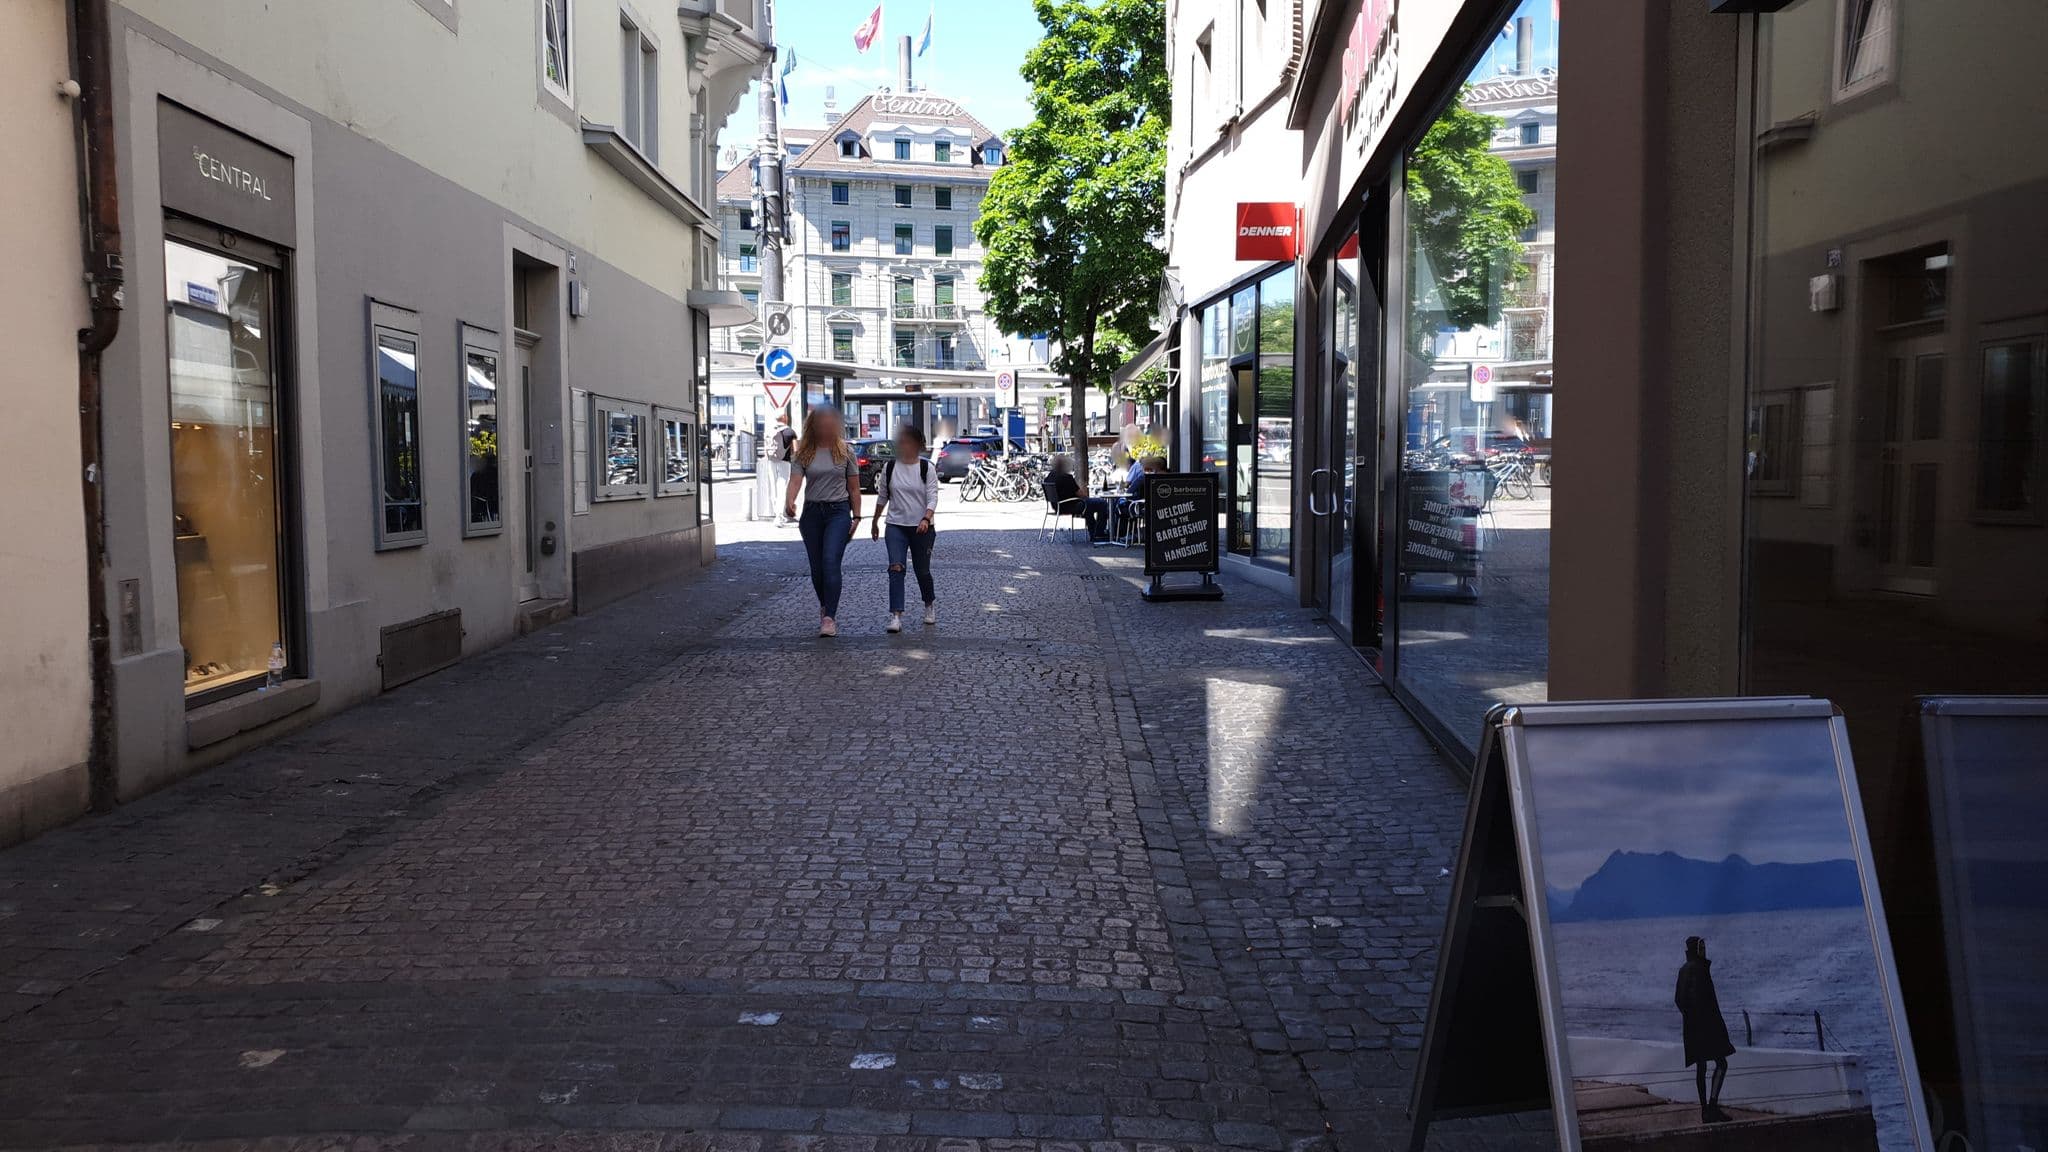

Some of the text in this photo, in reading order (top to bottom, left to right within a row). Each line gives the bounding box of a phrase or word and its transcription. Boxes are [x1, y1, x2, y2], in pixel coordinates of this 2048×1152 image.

[871, 88, 964, 116] Central
[199, 153, 271, 200] CENTRAL
[1240, 226, 1292, 236] DENNER
[1156, 501, 1195, 520] WELCOME
[1156, 520, 1208, 542] BARBERSHOP
[1164, 541, 1208, 562] HANDSOME
